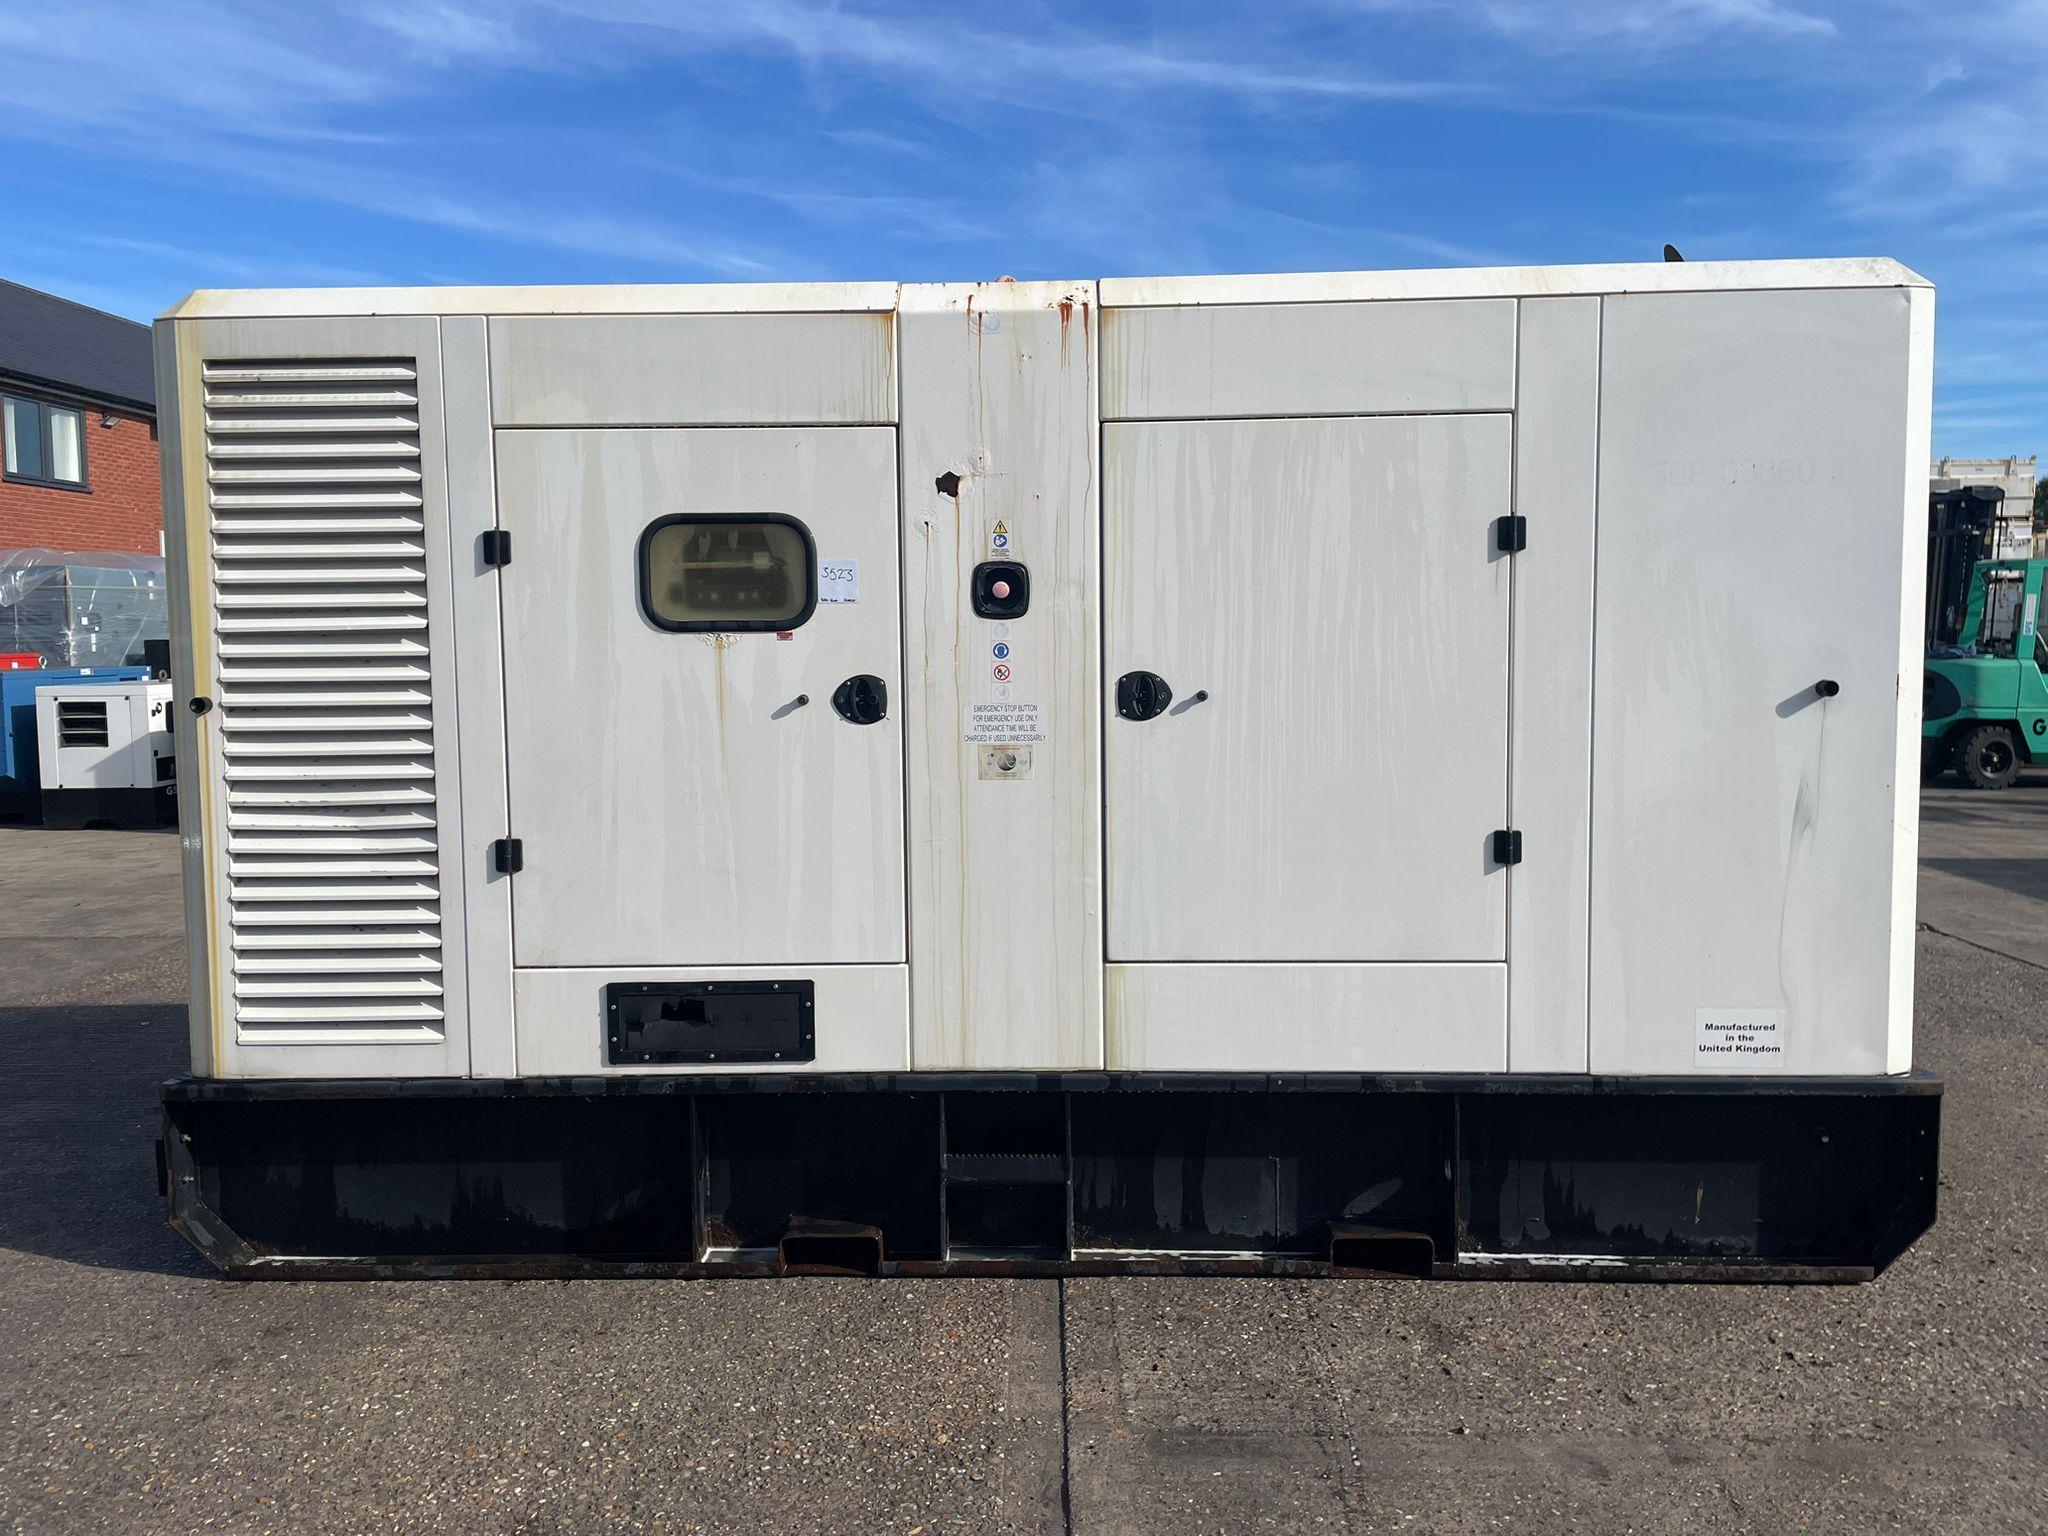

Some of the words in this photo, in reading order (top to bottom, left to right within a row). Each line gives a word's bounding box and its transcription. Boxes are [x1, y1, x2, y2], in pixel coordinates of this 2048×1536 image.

[984, 714, 1013, 722] EMERGENCY
[1014, 714, 1024, 722] USE
[1025, 714, 1038, 722] ONLY
[1006, 724, 1017, 732] TIME
[1018, 724, 1029, 732] WILL
[1030, 724, 1037, 732] BE
[1008, 734, 1047, 742] UNNECESSARILY
[1705, 1023, 1776, 1031] Manufactured
[1699, 1044, 1732, 1052] United
[1736, 1044, 1780, 1054] Kingdom
